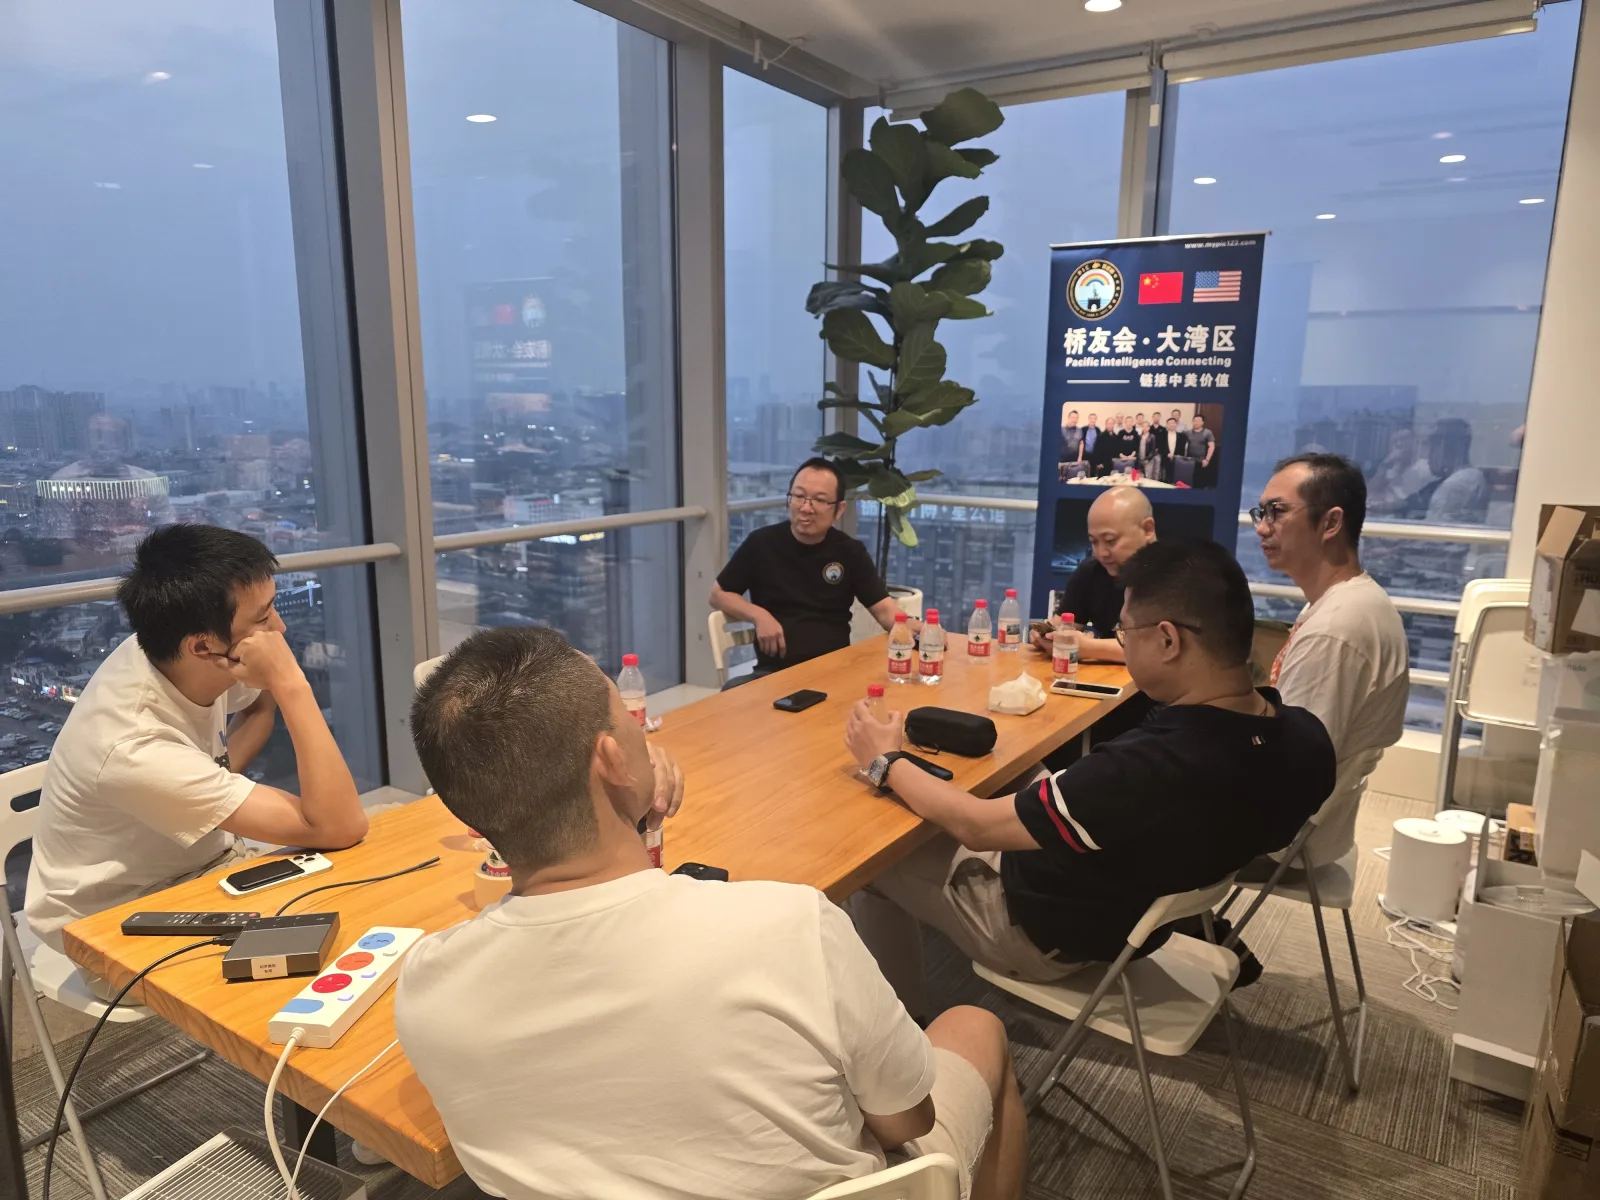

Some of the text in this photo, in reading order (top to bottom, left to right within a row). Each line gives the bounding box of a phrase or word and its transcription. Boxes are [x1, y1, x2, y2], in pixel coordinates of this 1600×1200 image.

[1063, 324, 1236, 355] 桥友会·大湾区
[1065, 355, 1232, 369] Pacific Intelligence Connecting
[1139, 372, 1230, 388] 链接中美价值
